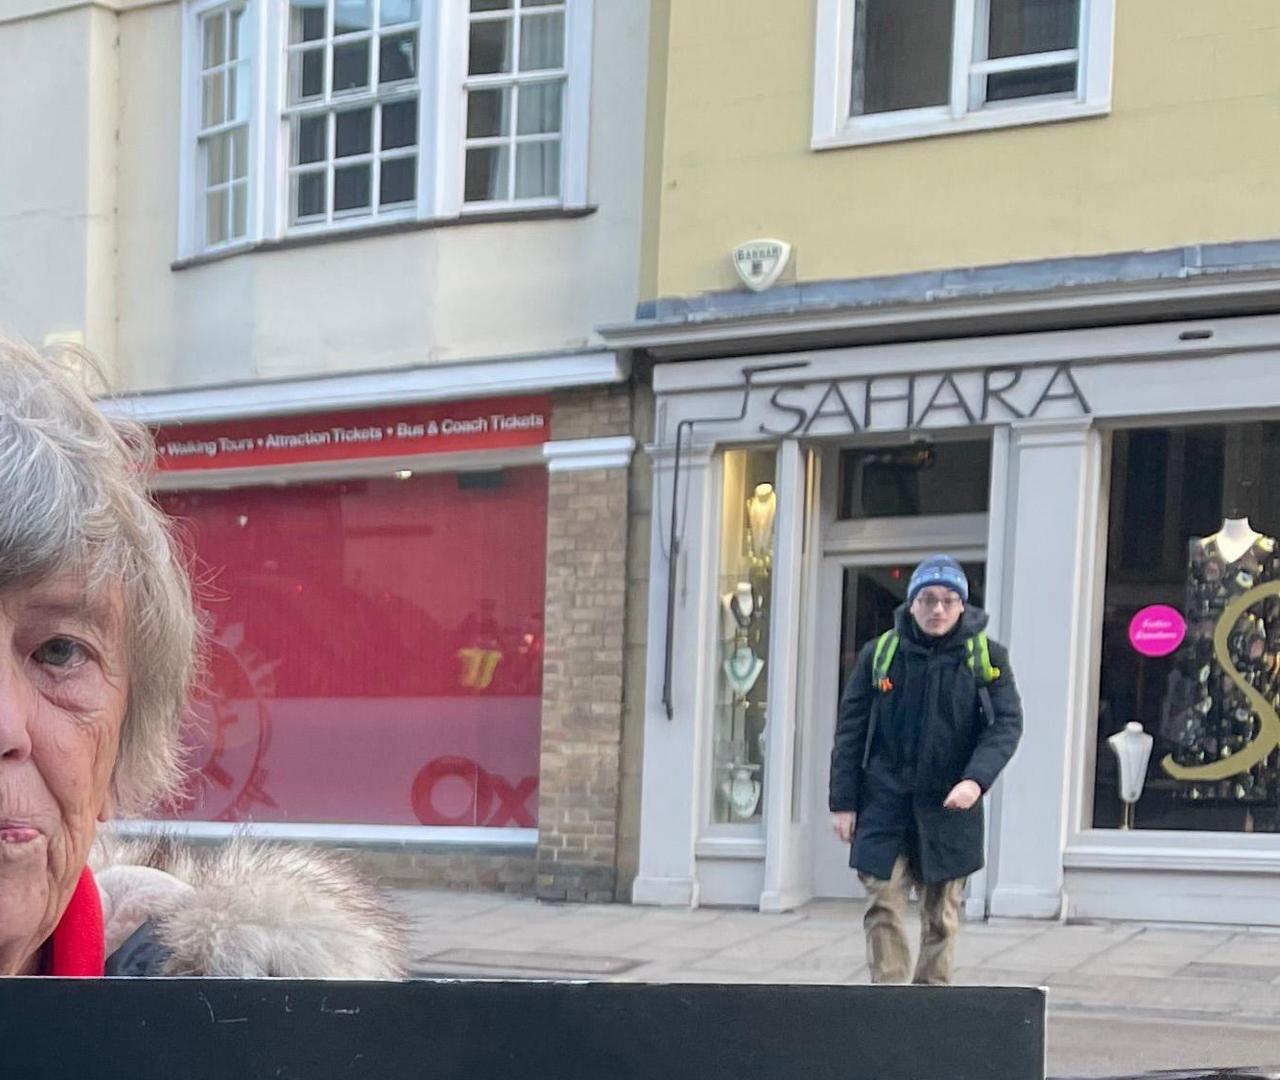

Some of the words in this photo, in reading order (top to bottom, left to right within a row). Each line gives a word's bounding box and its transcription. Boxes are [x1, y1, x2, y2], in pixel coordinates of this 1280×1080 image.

[758, 362, 1091, 437] SAHARA
[167, 439, 216, 457] Walking
[219, 437, 254, 452] Tours
[265, 430, 331, 449] Attraction
[332, 426, 382, 444] Tickets
[397, 422, 424, 438] Bus
[441, 416, 488, 436] Coach
[490, 413, 544, 433] Tickets
